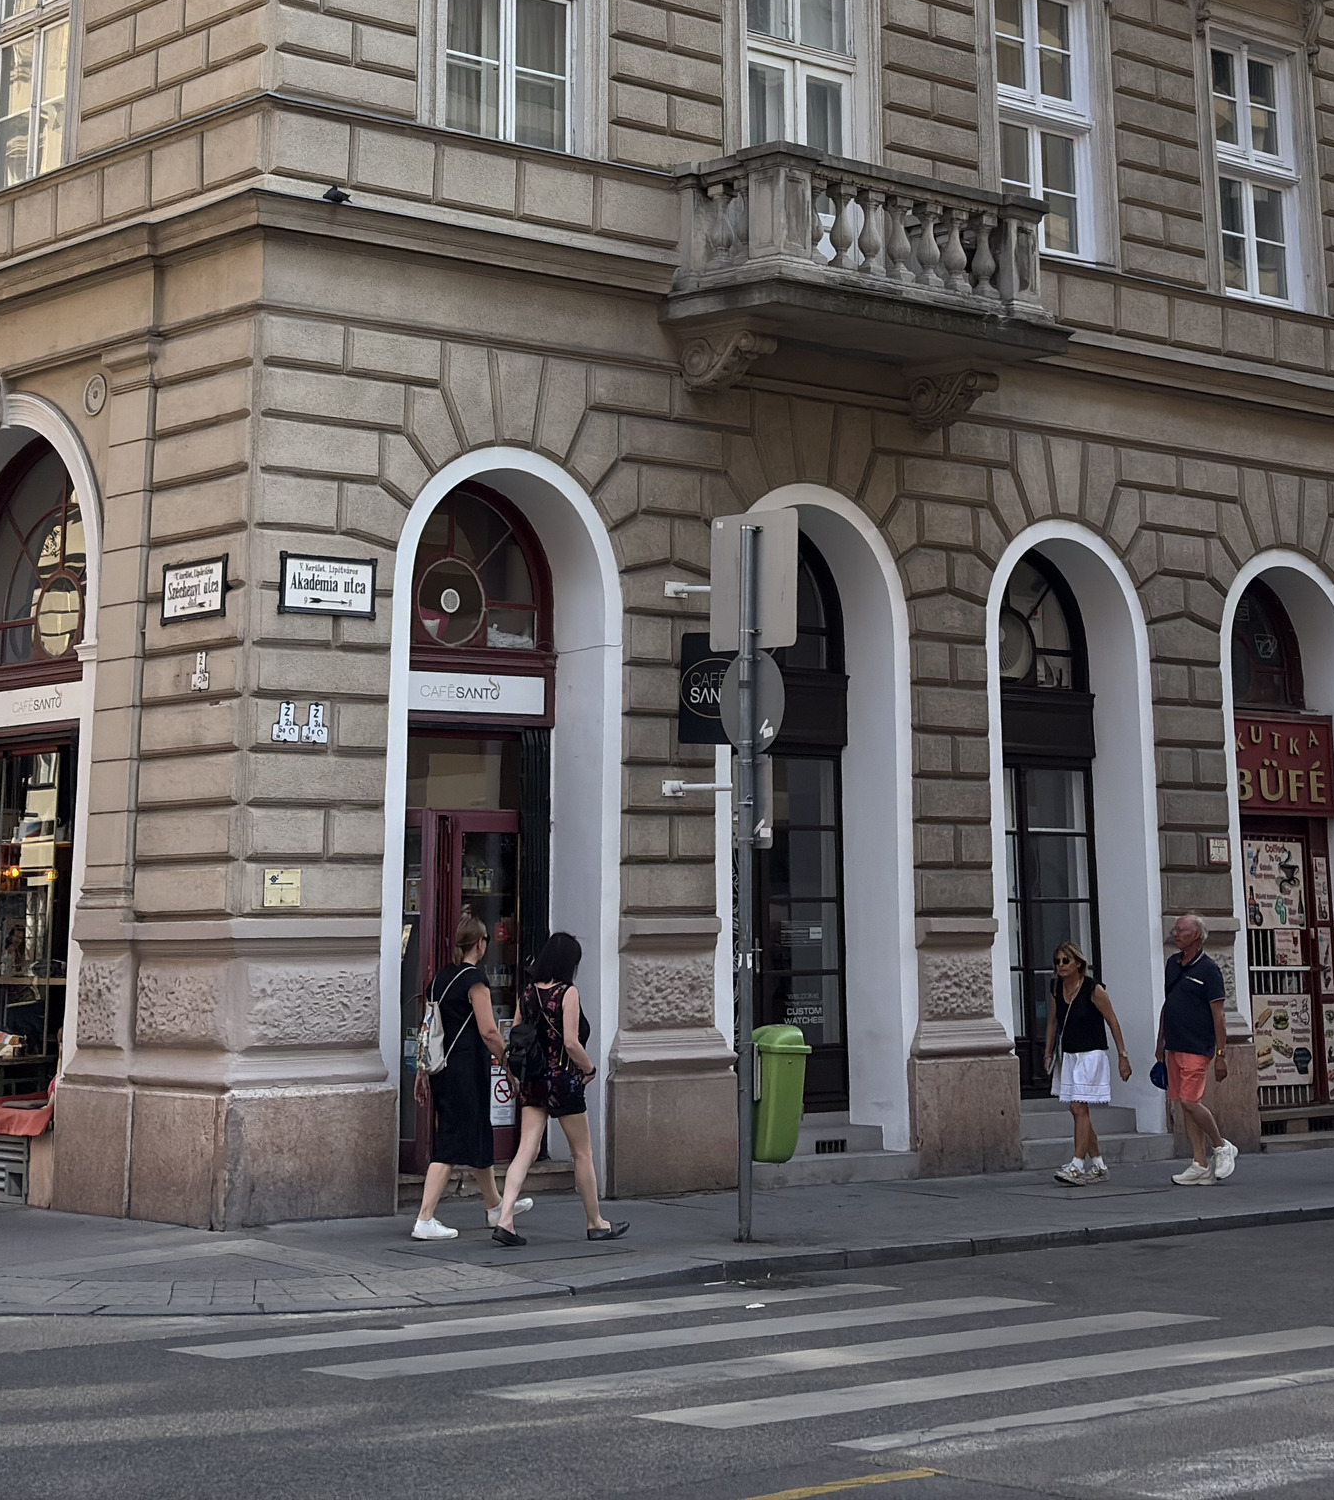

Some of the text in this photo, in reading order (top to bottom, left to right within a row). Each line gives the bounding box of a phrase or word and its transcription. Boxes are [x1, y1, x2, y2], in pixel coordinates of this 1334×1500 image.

[290, 571, 366, 594] Akadémia utca
[284, 707, 290, 716] Z
[313, 709, 319, 718] Z
[1235, 725, 1319, 756] KUTKA
[1238, 758, 1326, 803] BÜFÉ
[787, 1007, 822, 1015] CUSTOM
[784, 1016, 823, 1024] WATCHES
